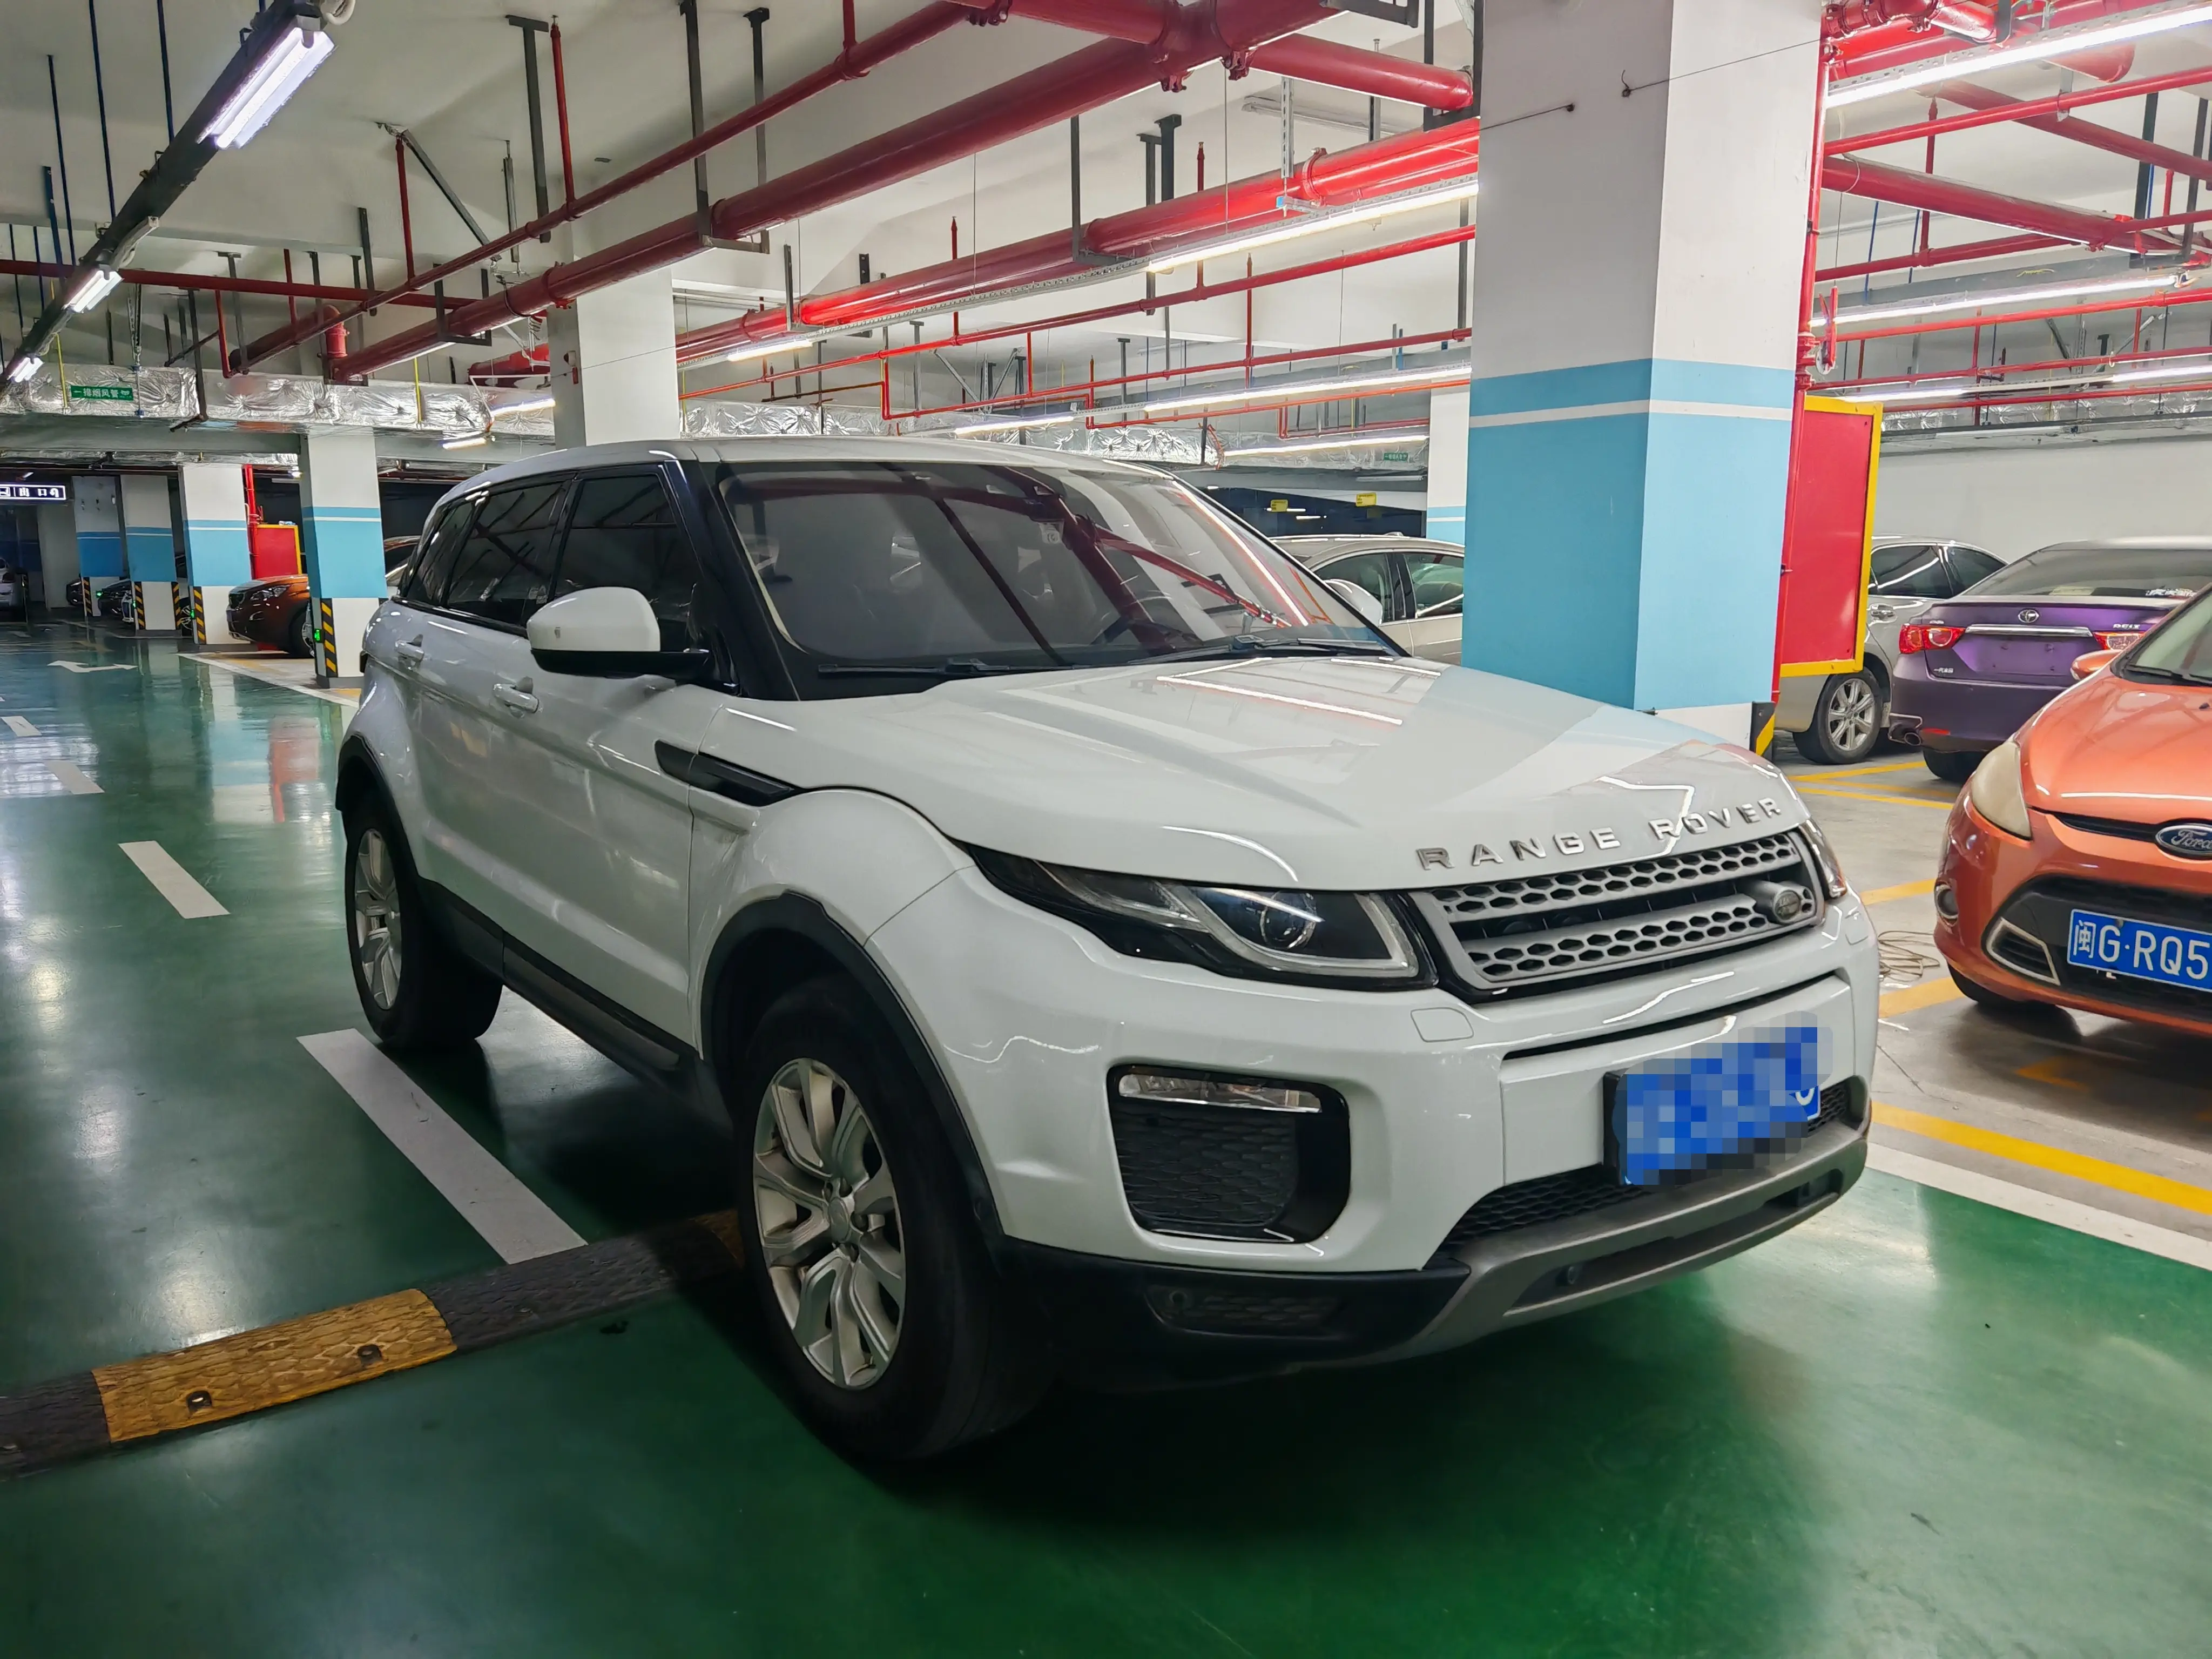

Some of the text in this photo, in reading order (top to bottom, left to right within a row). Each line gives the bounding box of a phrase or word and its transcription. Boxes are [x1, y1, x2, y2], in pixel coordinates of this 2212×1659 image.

[19, 487, 48, 497] 出口
[1415, 797, 1782, 871] RANGE ROVER
